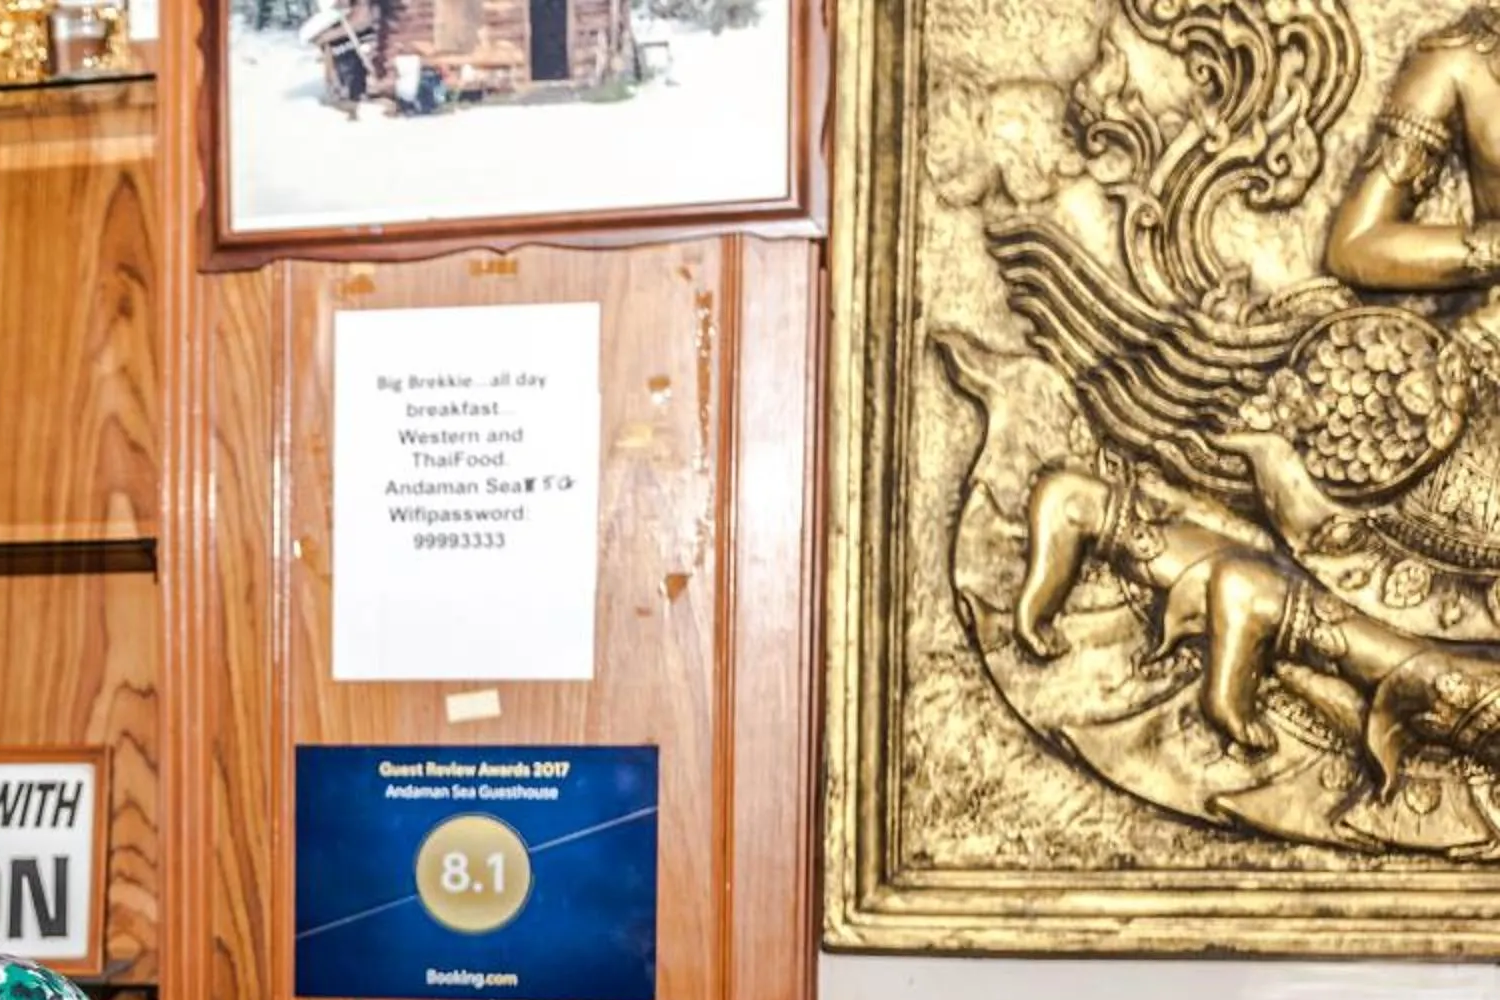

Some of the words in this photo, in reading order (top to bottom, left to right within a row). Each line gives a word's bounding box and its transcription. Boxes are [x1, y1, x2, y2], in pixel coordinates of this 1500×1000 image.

[377, 375, 403, 393] Big
[516, 371, 547, 389] day
[398, 429, 480, 445] Western
[486, 427, 523, 443] and
[385, 478, 478, 496] Andaman
[413, 532, 506, 550] 99993333
[533, 761, 570, 777] 2017
[385, 784, 449, 799] Andaman
[451, 784, 476, 799] Sea
[441, 852, 506, 893] 8.1
[426, 969, 519, 989] Booking.com
